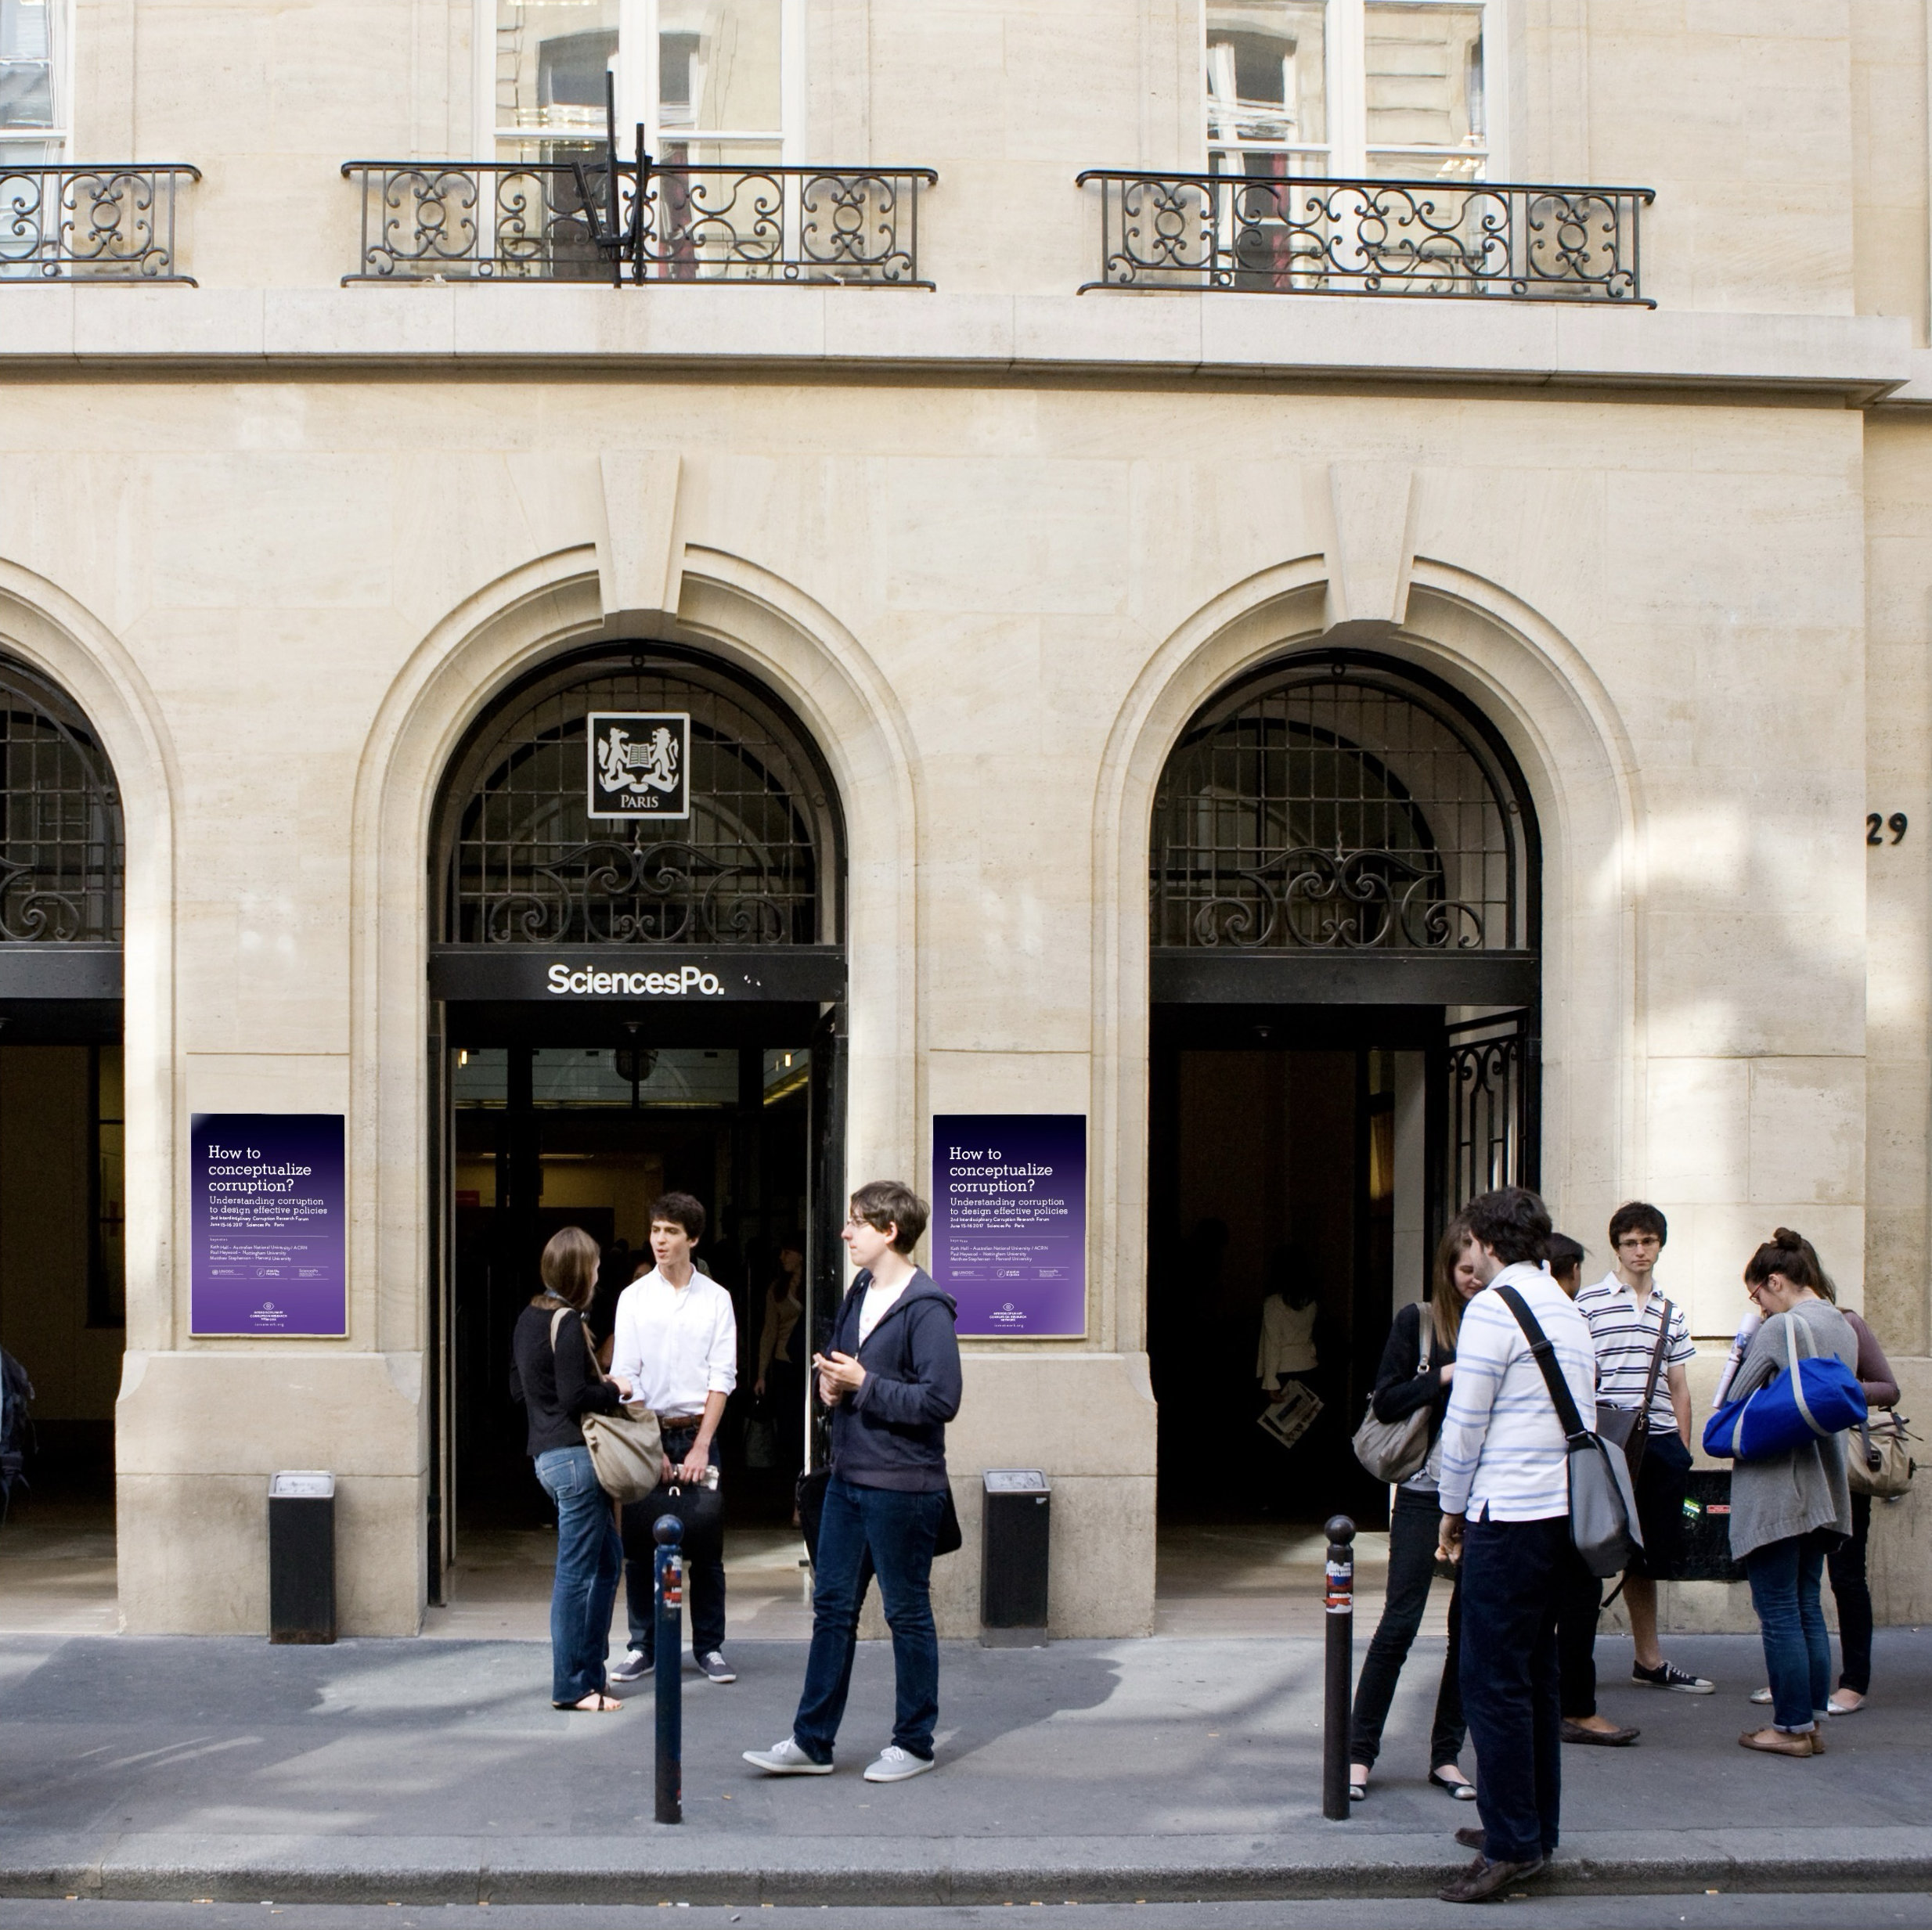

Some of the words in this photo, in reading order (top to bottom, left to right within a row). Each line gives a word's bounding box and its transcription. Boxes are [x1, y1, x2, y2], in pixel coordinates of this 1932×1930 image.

[620, 794, 658, 808] PARIS
[1866, 812, 1908, 845] 29
[546, 964, 726, 995] SciencesPo.
[208, 1145, 242, 1159] How
[247, 1147, 261, 1159] to
[950, 1147, 983, 1160] How
[987, 1148, 1002, 1160] to
[208, 1163, 312, 1178] conceptualize
[950, 1163, 1053, 1179] conceptualize
[208, 1179, 294, 1194] corruption?
[950, 1179, 1036, 1195] corruption?
[210, 1196, 275, 1206] Understanding
[278, 1197, 324, 1206] corruption
[950, 1197, 1015, 1208] Understanding
[1018, 1198, 1065, 1208] corruption
[220, 1205, 251, 1215] design
[293, 1207, 327, 1215] policies
[961, 1207, 990, 1217] design
